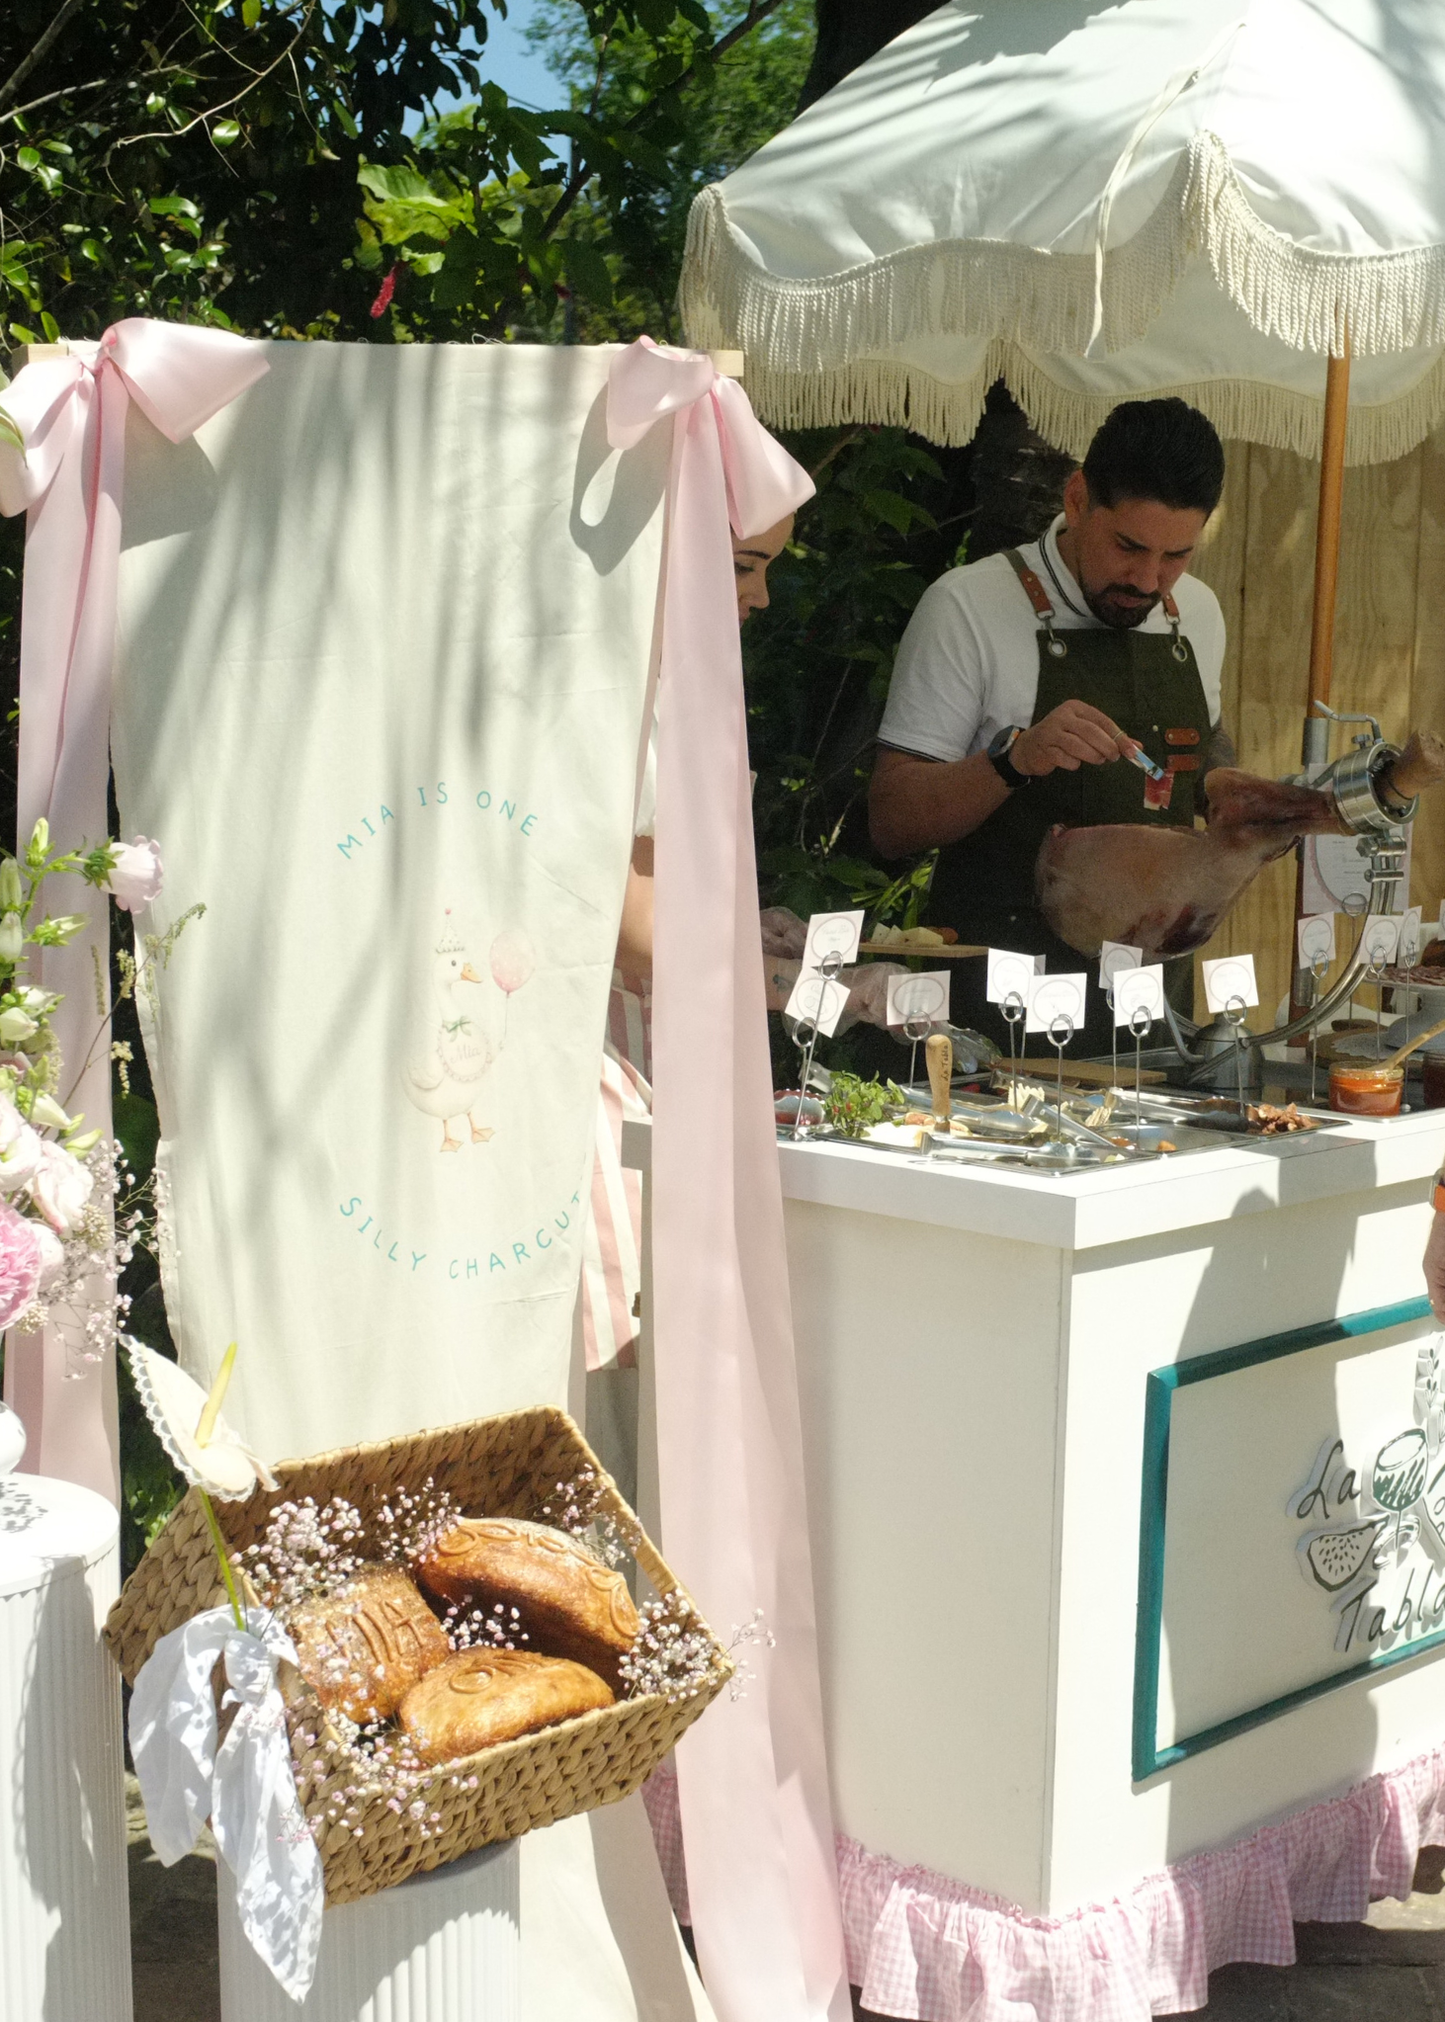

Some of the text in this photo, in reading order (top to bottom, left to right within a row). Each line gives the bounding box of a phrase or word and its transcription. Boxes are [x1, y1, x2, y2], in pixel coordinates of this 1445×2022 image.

[336, 781, 538, 860] MIA IS ONE
[449, 1043, 482, 1064] Mia
[339, 1196, 428, 1272] SILLY
[1296, 1438, 1362, 1520] La
